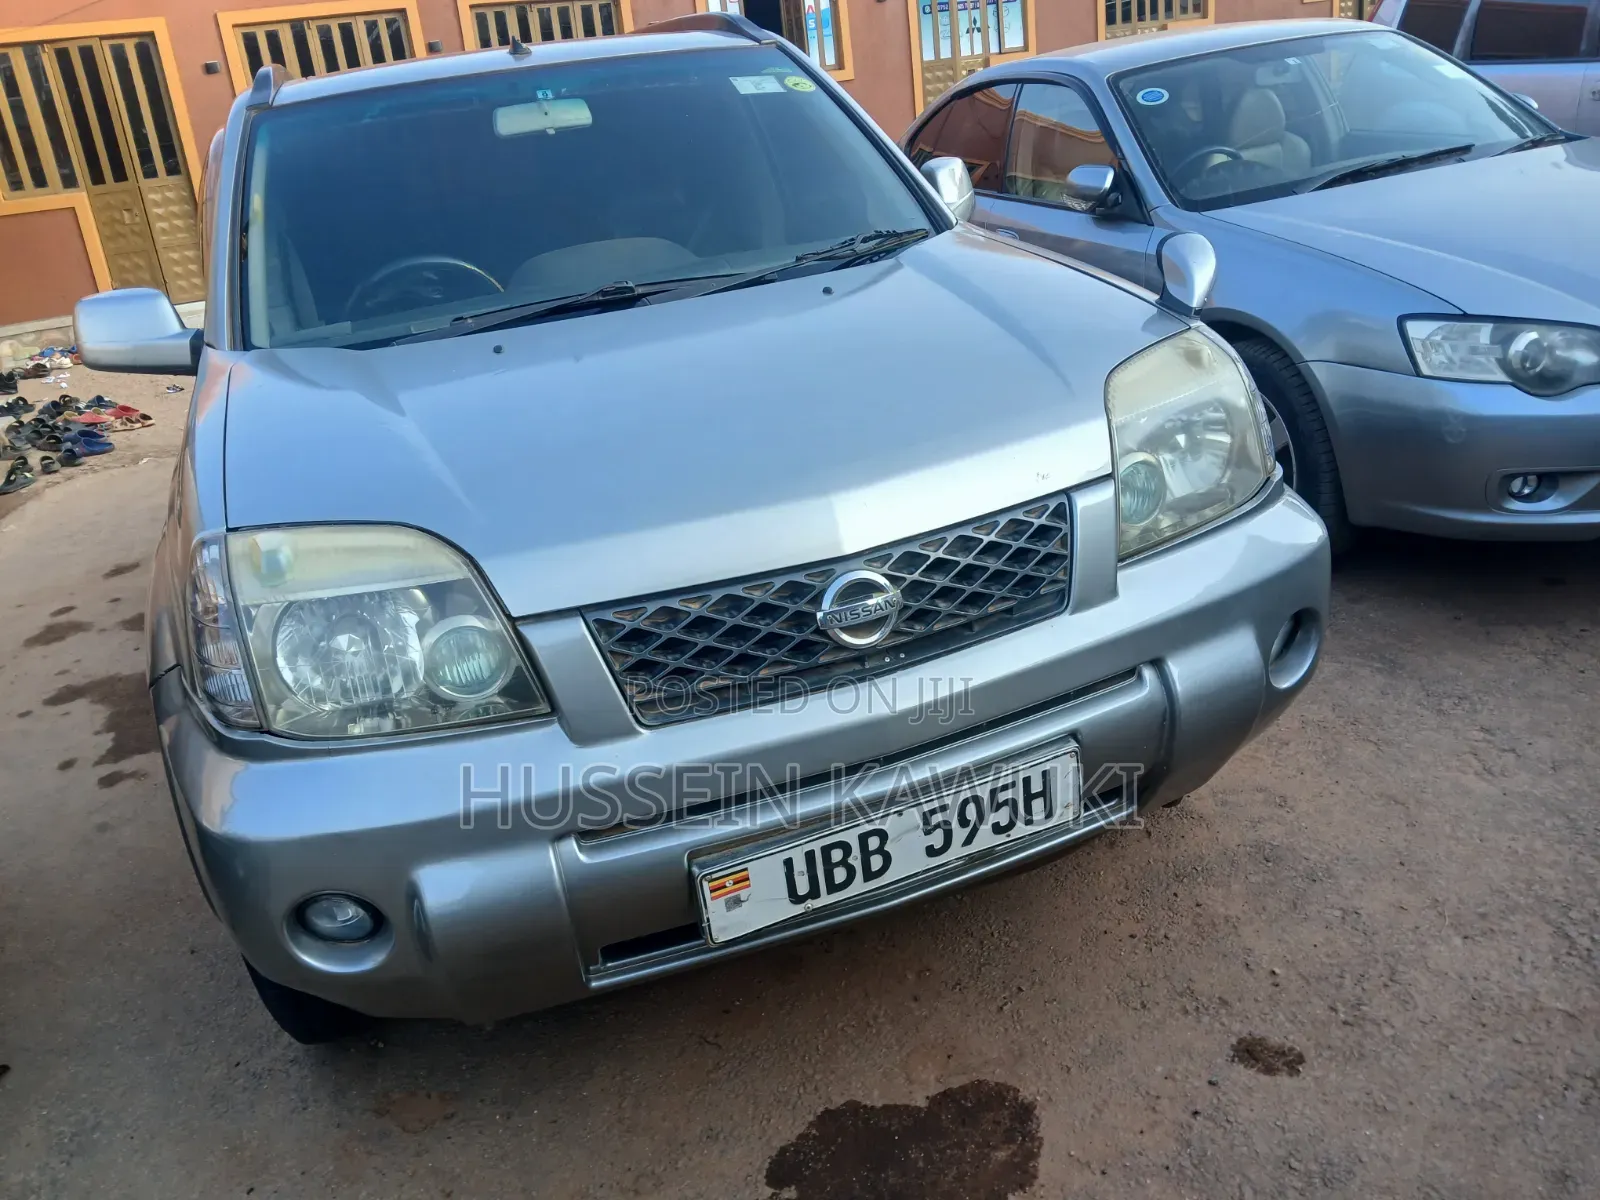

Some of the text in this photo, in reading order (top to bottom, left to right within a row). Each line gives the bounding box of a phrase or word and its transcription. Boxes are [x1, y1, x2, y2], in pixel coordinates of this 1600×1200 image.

[827, 597, 897, 625] NISSAN
[783, 769, 1054, 905] UBB 595H
